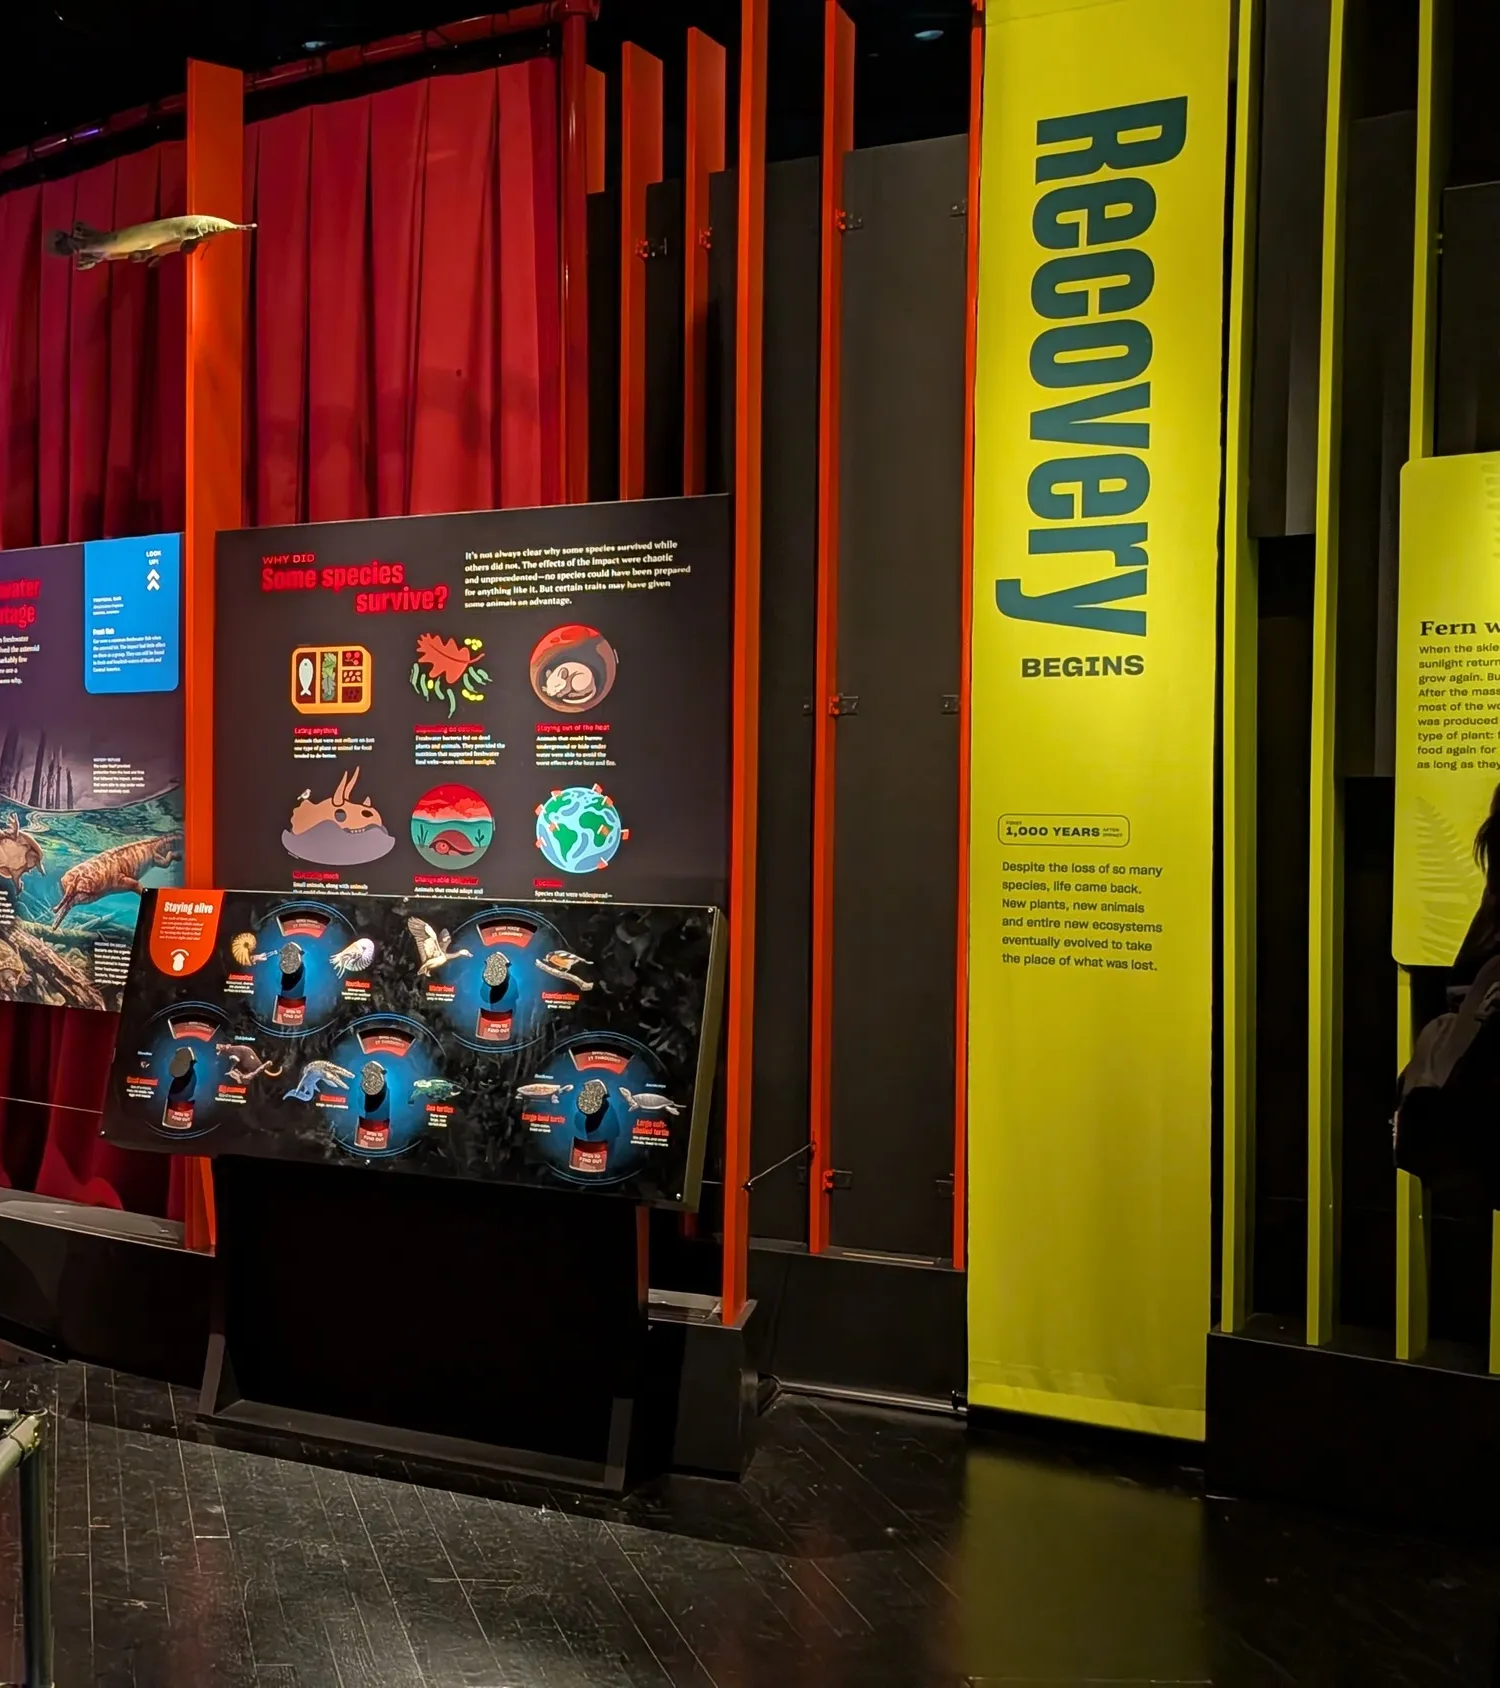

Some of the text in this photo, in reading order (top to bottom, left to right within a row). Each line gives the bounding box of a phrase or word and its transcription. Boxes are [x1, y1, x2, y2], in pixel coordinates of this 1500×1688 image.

[996, 96, 1188, 637] Recovery
[466, 551, 478, 560] It's
[480, 551, 492, 559] not
[495, 550, 521, 559] always
[523, 548, 541, 557] clear
[544, 548, 560, 557] why
[586, 544, 615, 554] species
[618, 541, 652, 551] survived
[654, 541, 678, 550] while
[263, 554, 314, 564] WHY DID
[465, 553, 673, 572] others did not. The effects of the impact were chaotic
[262, 561, 403, 593] Some species
[465, 576, 479, 584] and
[557, 572, 585, 581] species
[588, 570, 609, 578] could
[612, 569, 630, 577] have
[633, 568, 652, 576] been
[654, 566, 690, 576] prepared
[465, 580, 670, 597] for anything like it. But certain traits may have given
[357, 586, 447, 613] survive?
[465, 601, 484, 609] some
[486, 599, 516, 608] animals
[530, 597, 572, 607] advantage.
[1420, 621, 1476, 636] Fern
[3, 635, 29, 643] freshwater
[1420, 646, 1450, 654] When
[1454, 644, 1473, 653] the
[1022, 655, 1144, 677] BEGINS
[1419, 659, 1463, 669] sunlight
[1419, 675, 1446, 685] grow
[1450, 674, 1483, 684] again.
[1418, 688, 1446, 697] After
[1450, 688, 1467, 696] the
[1418, 703, 1446, 712] most
[1450, 703, 1462, 711] of
[1465, 703, 1483, 711] the
[1418, 717, 1499, 727] was produced
[1418, 732, 1443, 742] type
[1446, 731, 1458, 740] of
[1461, 731, 1494, 741] plant:
[1418, 745, 1497, 756] food again for
[1417, 761, 1429, 769] as
[1434, 760, 1457, 770] long
[1006, 826, 1100, 838] 1,000 YEARS
[1003, 862, 1163, 877] Despite the loss of so many
[1003, 881, 1141, 894] species, life came back.
[164, 902, 213, 915] Staying alive
[1003, 899, 1145, 913] New plants, new animals
[1003, 918, 1162, 933] and entire new ecosystems
[1003, 936, 1152, 951] eventually evolved to take
[1003, 953, 1157, 971] the place of what was lost.
